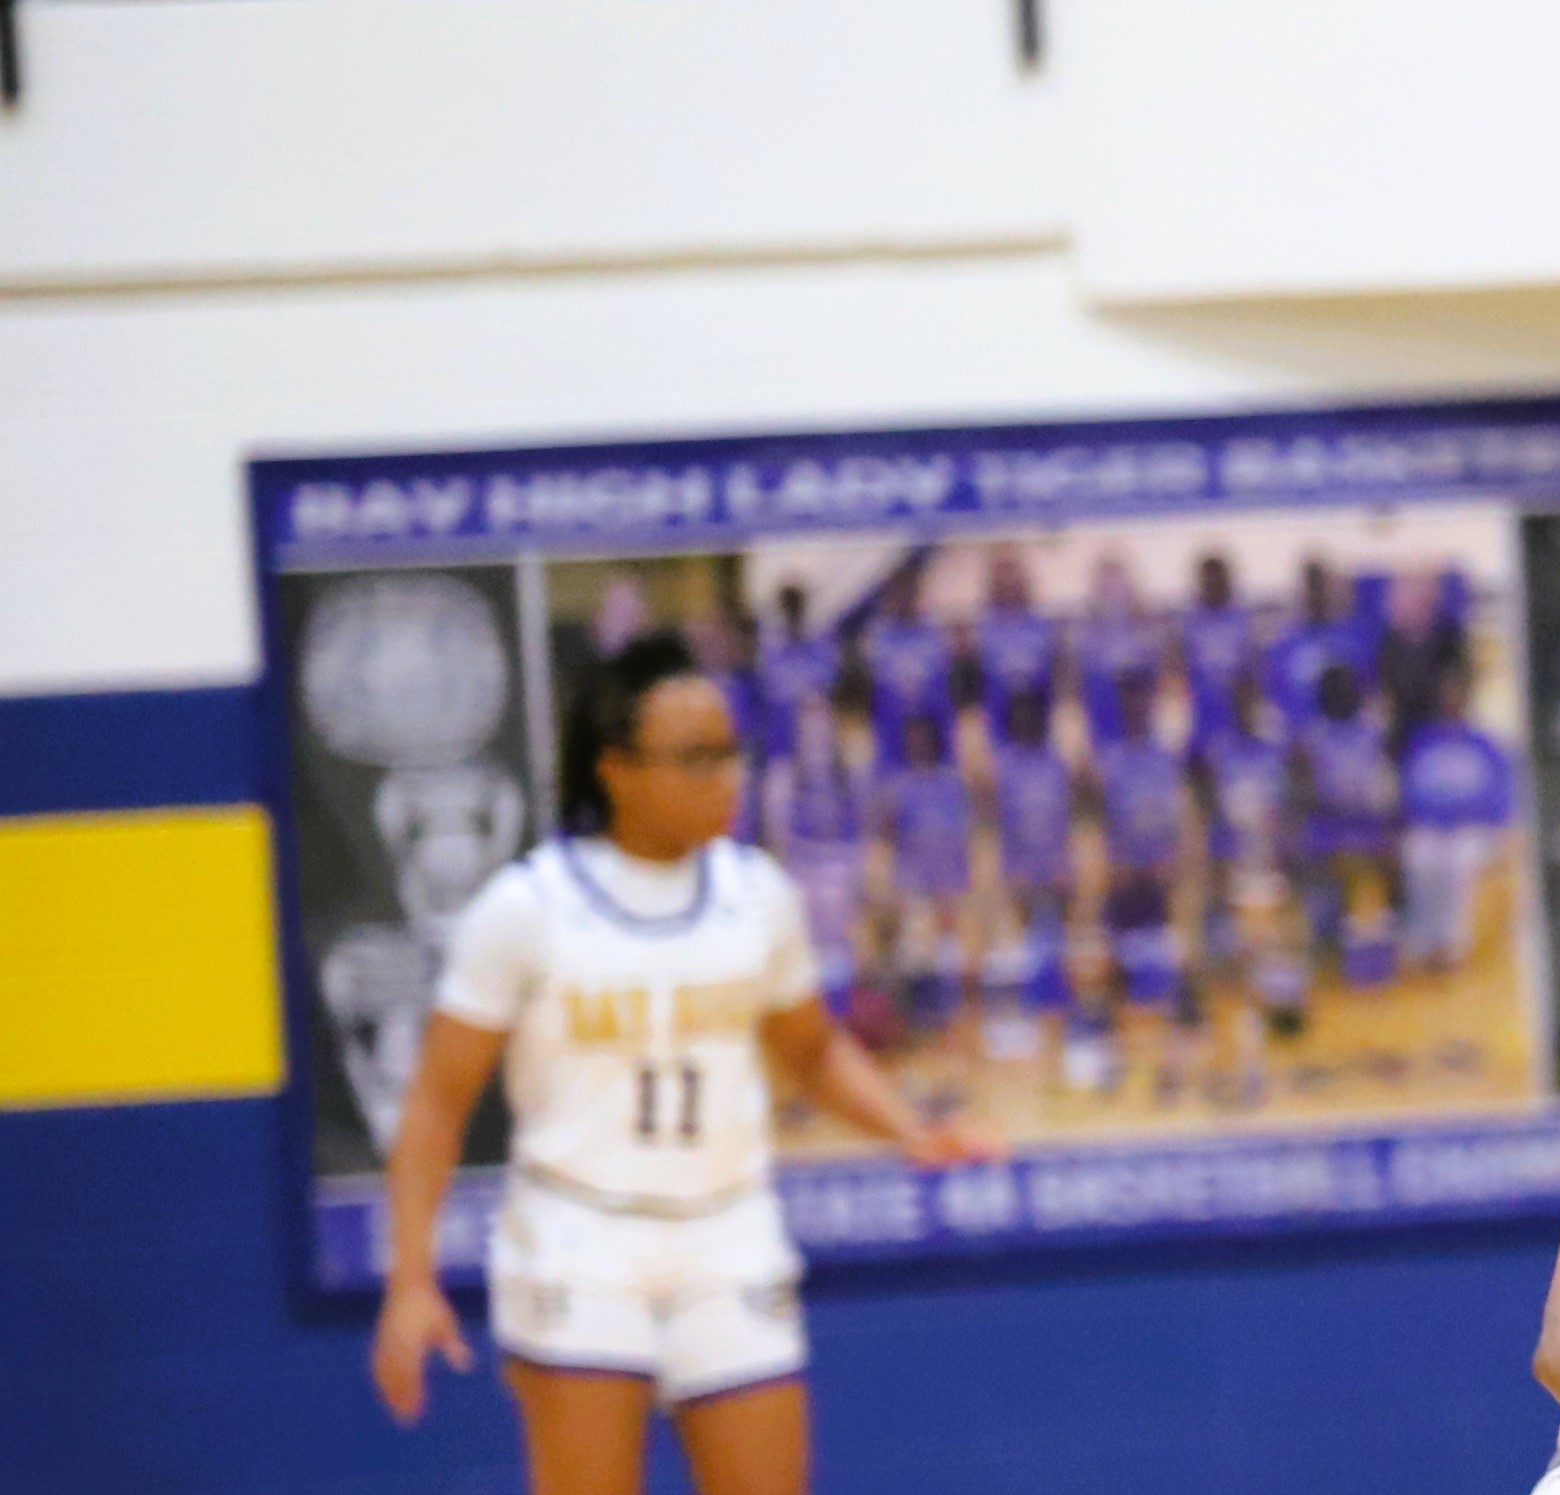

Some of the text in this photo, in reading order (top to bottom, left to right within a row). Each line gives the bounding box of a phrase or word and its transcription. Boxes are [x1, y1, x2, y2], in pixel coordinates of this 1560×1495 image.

[290, 472, 476, 538] BAY
[486, 464, 710, 533] HIGH
[724, 453, 956, 525] LADY
[636, 1057, 702, 1140] 11
